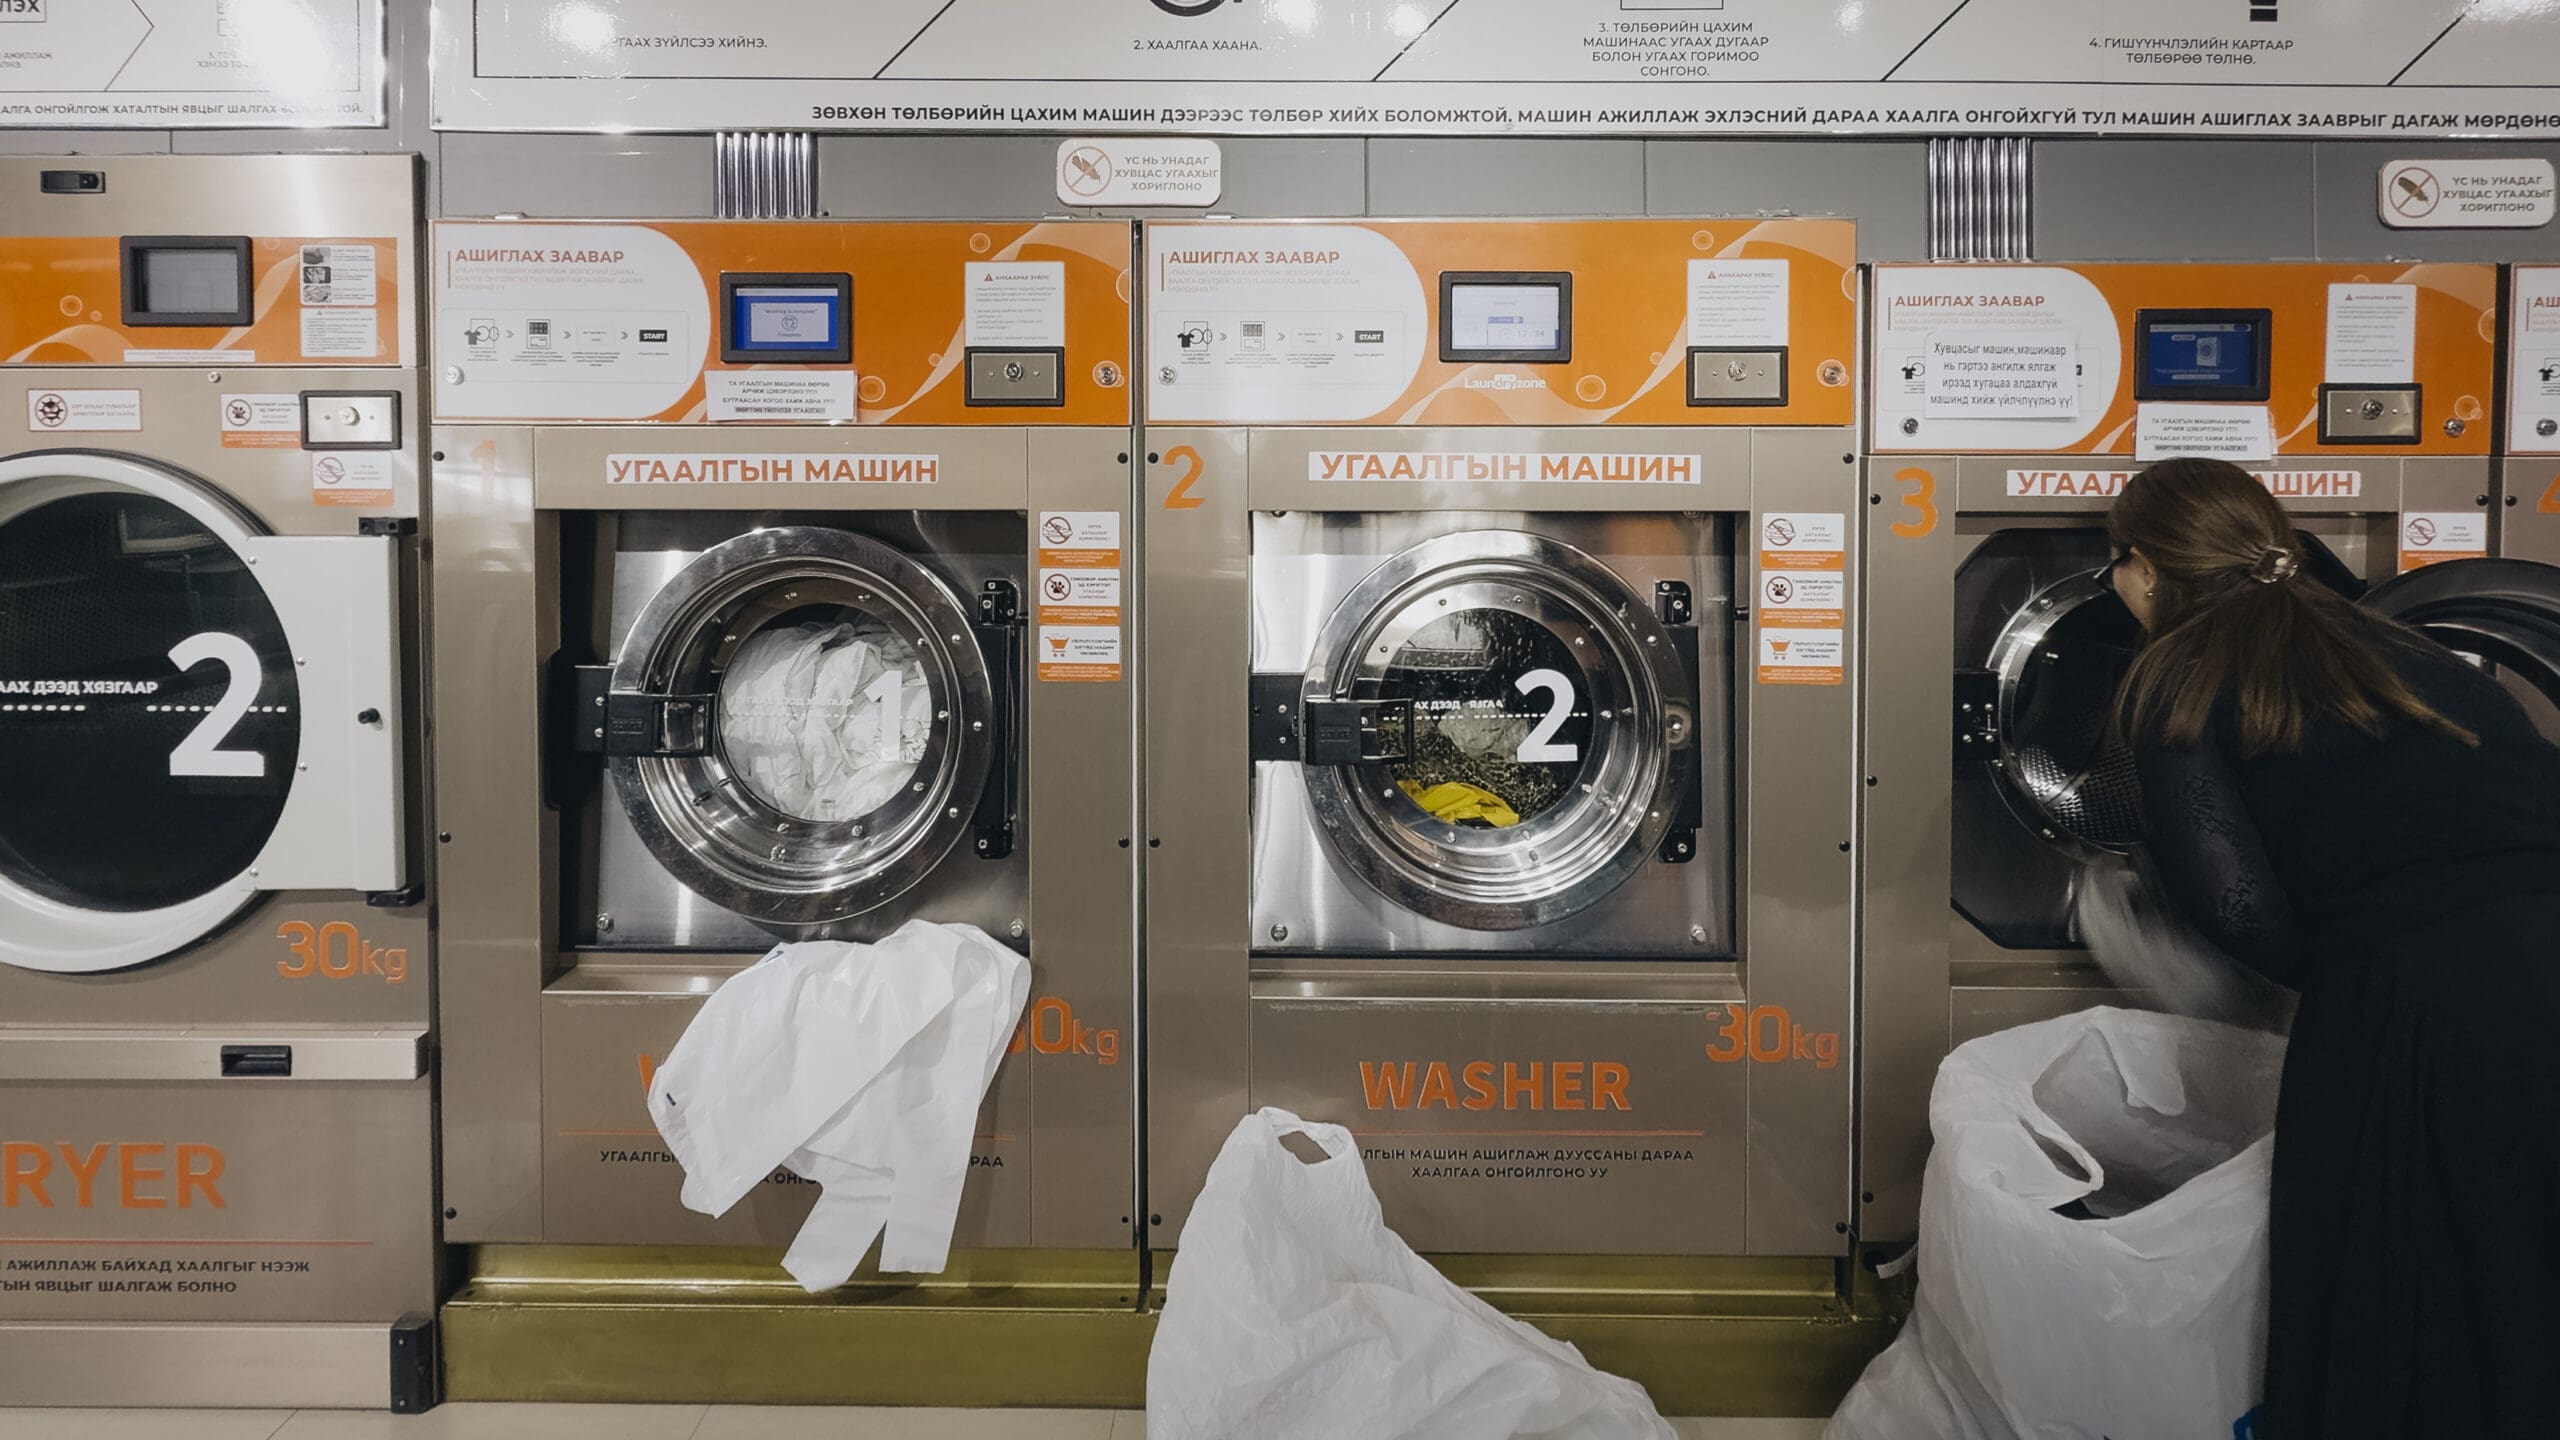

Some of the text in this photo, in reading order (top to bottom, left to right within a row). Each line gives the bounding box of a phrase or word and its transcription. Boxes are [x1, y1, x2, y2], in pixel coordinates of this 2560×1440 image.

[1598, 21, 1753, 34] 3. ТӨЛБӨРИЙН ЦАХИМ
[655, 35, 715, 48] ЗҮЙЛСЭЭ
[718, 36, 768, 48] ХИЙНЭ.
[1133, 40, 1262, 51] 2. ХААЛГАА ХААНА.
[1583, 37, 1769, 48] МАШИНААС УГААХ ДУГААР
[2089, 37, 2294, 51] 4. ГИШҮҮНЧЛЭЛИЙН КАРТААР
[1592, 52, 1759, 62] БОЛОН УГААХ ГОРИМОО
[2126, 53, 2256, 65] ТӨЛБӨРӨӨ ТӨЛНӨ.
[1640, 66, 1710, 77] СОНГОНО.
[0, 105, 31, 114] АЛГА
[35, 104, 109, 114] ОНГОЙЛГОЖ
[113, 105, 178, 114] ХАТАЛТЫН
[183, 105, 223, 116] ЯВЦЫГ
[227, 105, 276, 114] ШАЛГАХ
[812, 104, 2560, 130] ЗӨВХӨН ТӨЛБӨРИЙН ЦАХИМ МАШИН ДЭЭРЭЭС ТӨЛБӨР ХИЙХ БОЛОМЖТОЙ. МАШИН АЖИЛЛАЖ ЭХЛЭСНИЙ ДАРАА ХААЛГА ОНГОЙХГҮЙ ТУЛ МАШИН АШИГЛАХ ЗААВРЫГ ДАГАЖ МӨРДӨНӨ
[1143, 156, 1159, 166] НЬ
[1162, 156, 1209, 166] УНАДАГ
[1114, 169, 1219, 179] ХУВЦАС УГААХЫГ
[1131, 182, 1202, 191] ХОРИГЛОНО
[2471, 176, 2488, 187] НЬ
[2491, 176, 2544, 187] УНАДАГ
[2443, 190, 2553, 200] ХУВЦАС УГААХЫГ
[2460, 203, 2535, 212] ХОРИГЛОНО
[455, 249, 625, 263] АШИГЛАХ ЗААВАР
[1168, 250, 1340, 264] АШИГЛАХ ЗААВАР
[1895, 296, 2045, 307] АШИГЛАХ ЗААВАР
[643, 332, 665, 340] START
[1934, 342, 1980, 357] Хувцасыг
[1943, 362, 2057, 373] нь гэртээ ангилж ялгаж
[1942, 379, 1971, 390] ирээд
[1973, 380, 2011, 391] хугацаа
[1930, 395, 1969, 405] машинд
[1971, 394, 1995, 405] хийж
[611, 459, 937, 483] УГААЛГЫН МАШИН
[1320, 454, 1692, 482] УГААЛГЫН МАШИН
[1163, 445, 1205, 510] 2
[2017, 472, 2353, 496] УГААЛ ШИН
[1890, 467, 1938, 538] 3
[33, 681, 80, 695] ДЭЭД
[83, 681, 158, 694] ХЯЗГААР
[168, 631, 264, 777] 2
[1431, 700, 1460, 711] ДЭЭД
[863, 670, 902, 762] 1
[1514, 668, 1578, 763] 2
[276, 920, 408, 984] 30kg
[1007, 996, 1119, 1065] 0kg
[1706, 1004, 1839, 1069] 30kg
[1358, 1060, 1632, 1111] WASHER
[600, 1151, 680, 1164] УГААЛГЫ
[970, 1155, 1004, 1168] РАА
[1362, 1149, 1694, 1162] ЛГЫН МАШИН АШИГЛАЖ ДУУССАНЫ ДАРАА
[3, 1141, 226, 1210] RYER
[1412, 1168, 1480, 1178] ХААЛГАА
[1485, 1165, 1585, 1178] ОНГОЙЛГОНО
[6, 1258, 310, 1274] АЖИЛЛАЖ БАЙХАД ХААЛГЫГ НЭЭЖ
[0, 1280, 237, 1294] ЫН ЯВЦЫГ ШАЛГАЖ БОЛНО
